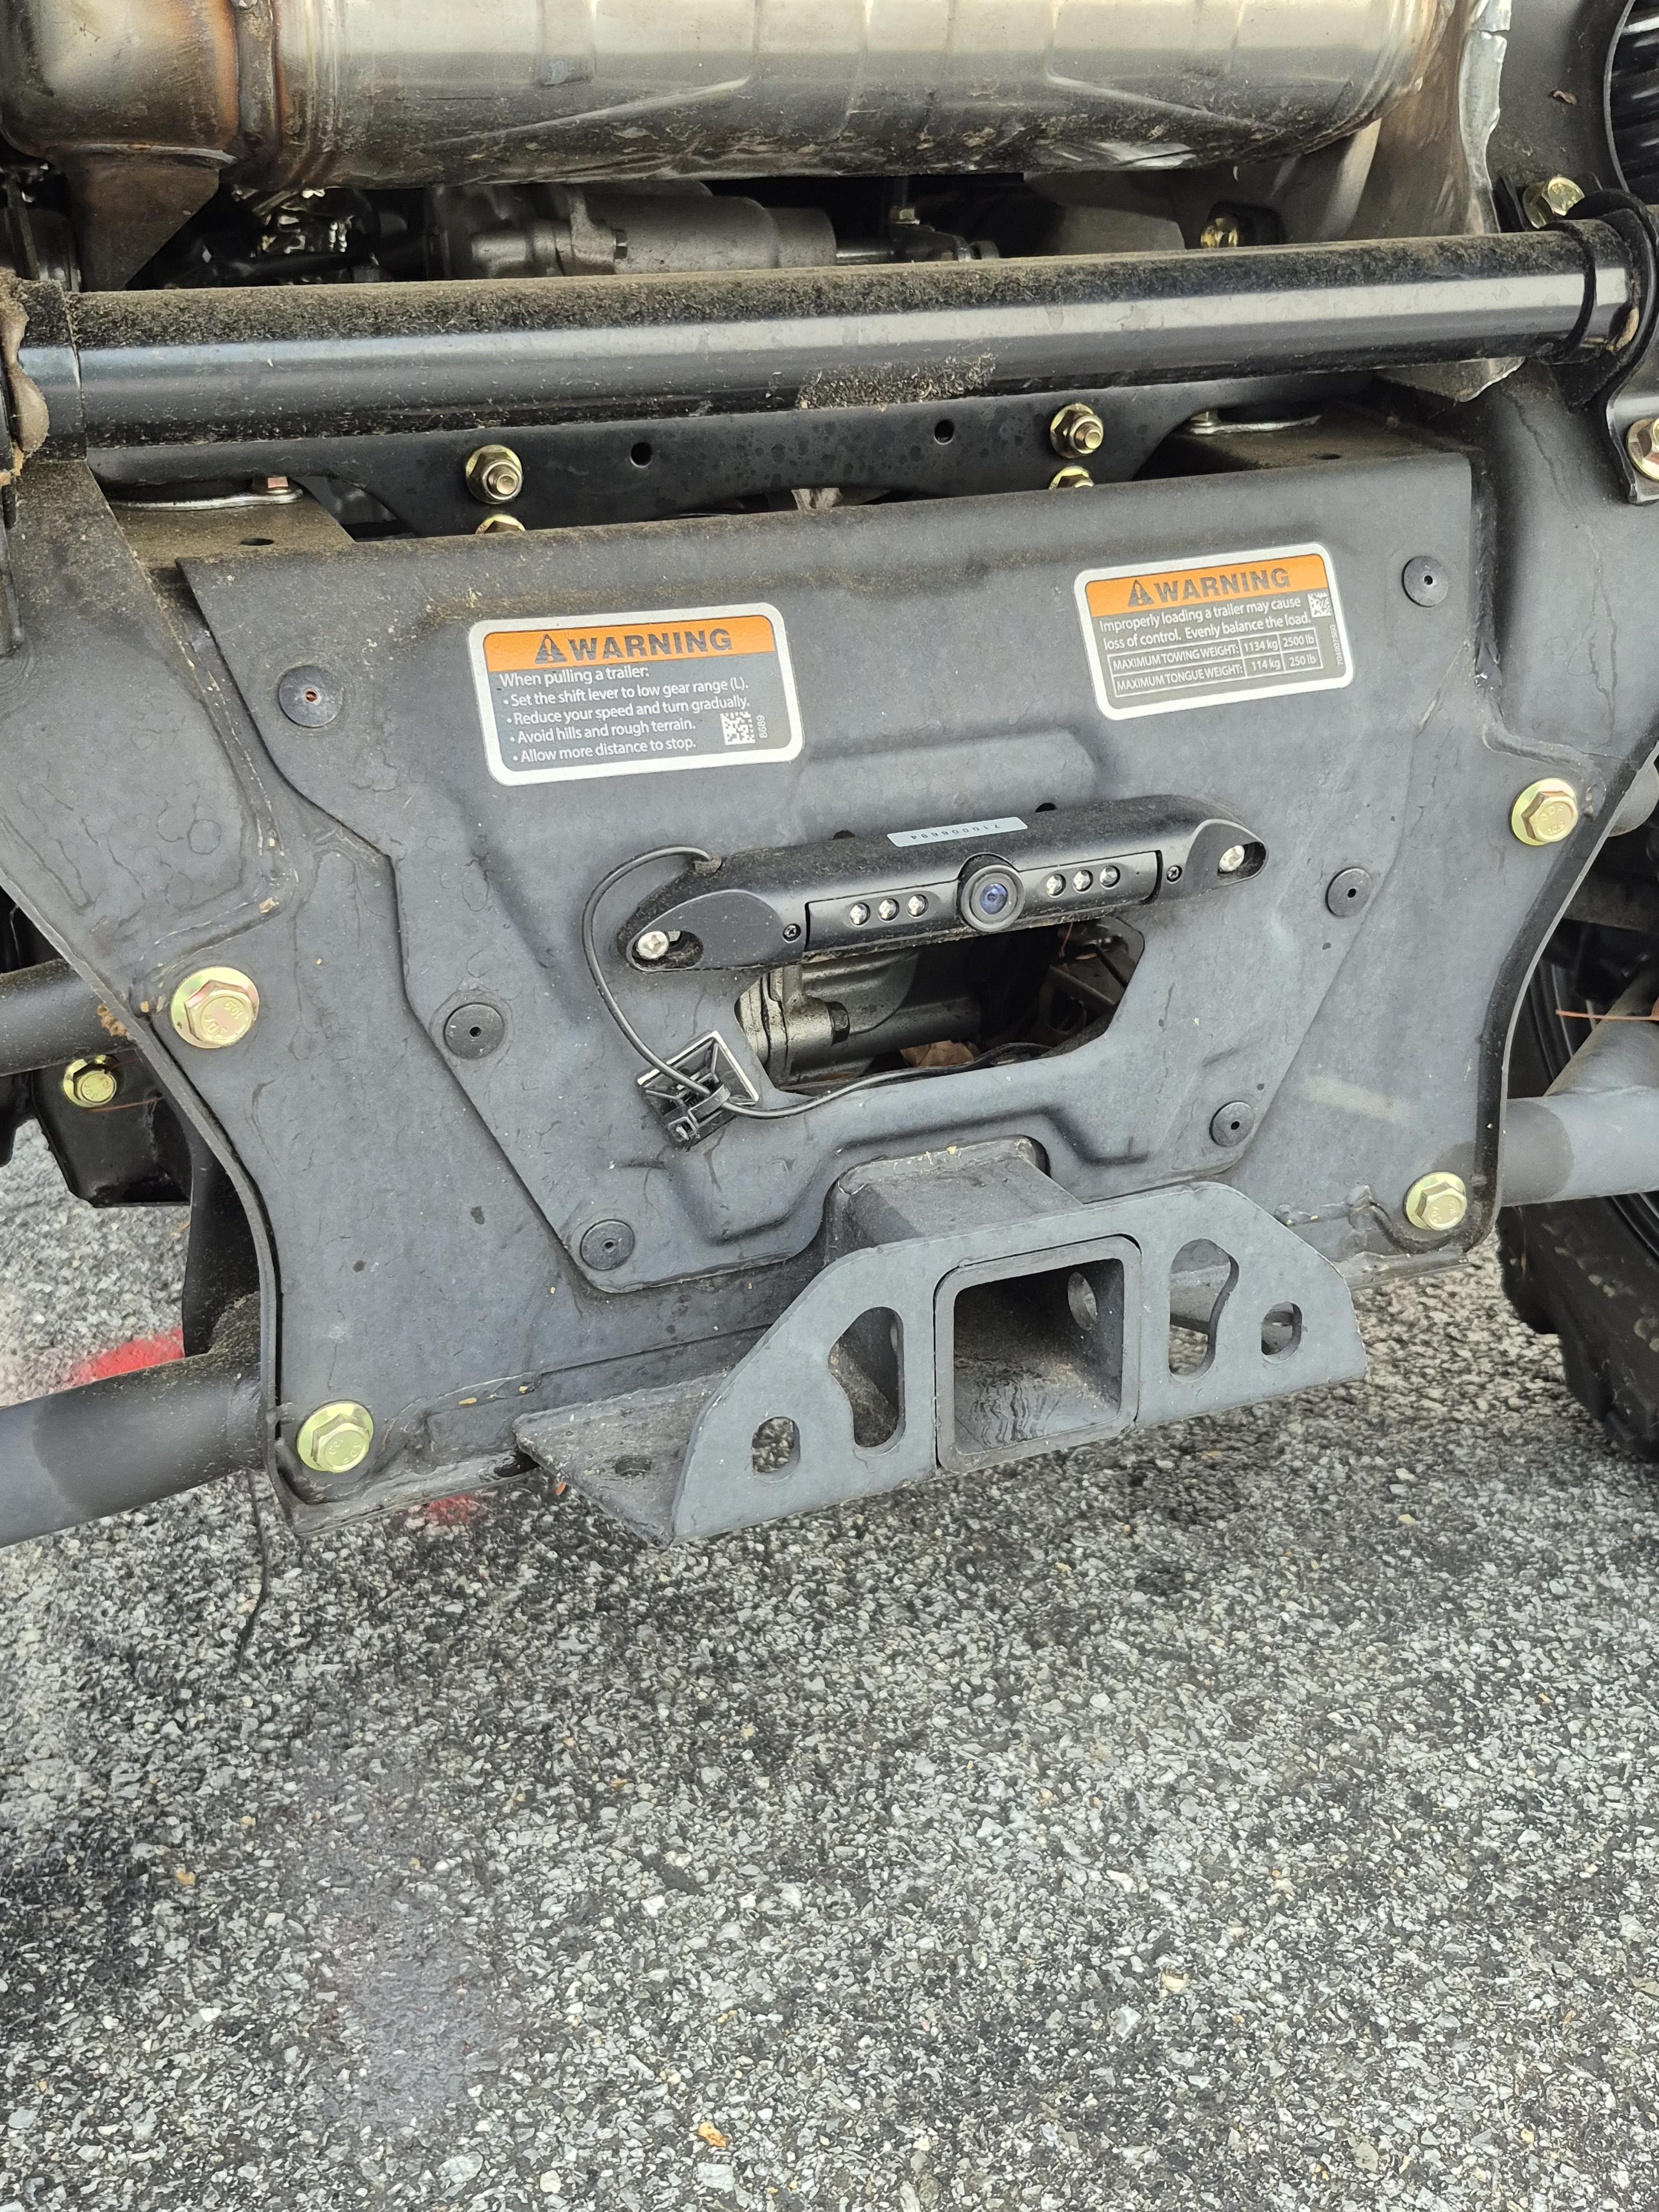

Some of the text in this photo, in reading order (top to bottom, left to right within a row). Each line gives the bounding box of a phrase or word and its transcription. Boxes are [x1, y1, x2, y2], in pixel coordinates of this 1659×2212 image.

[1153, 567, 1291, 603] WARNING
[1099, 597, 1301, 634] Improperly loading a trailer may cause
[1103, 611, 1312, 651] loss of control. Evenly balance the load.
[568, 628, 733, 661] WARNING
[1113, 634, 1314, 671] MAXIMUM TOWING WEIGHT: 1134 kg 2500 lb
[499, 672, 542, 687] When
[544, 669, 592, 687] pulling
[596, 670, 603, 681] a
[1117, 654, 1316, 691] MAXIMUM TONGUE WEIGHT: 114 kg 250 lb
[510, 677, 749, 707] Set the shift lever to low gear range (L).
[513, 695, 750, 725] Reduce your speed and turn gradually.
[518, 718, 696, 744] Avoid hills and rough terrain.
[756, 715, 768, 738] 8689
[521, 738, 696, 763] Allow more distance to stop.
